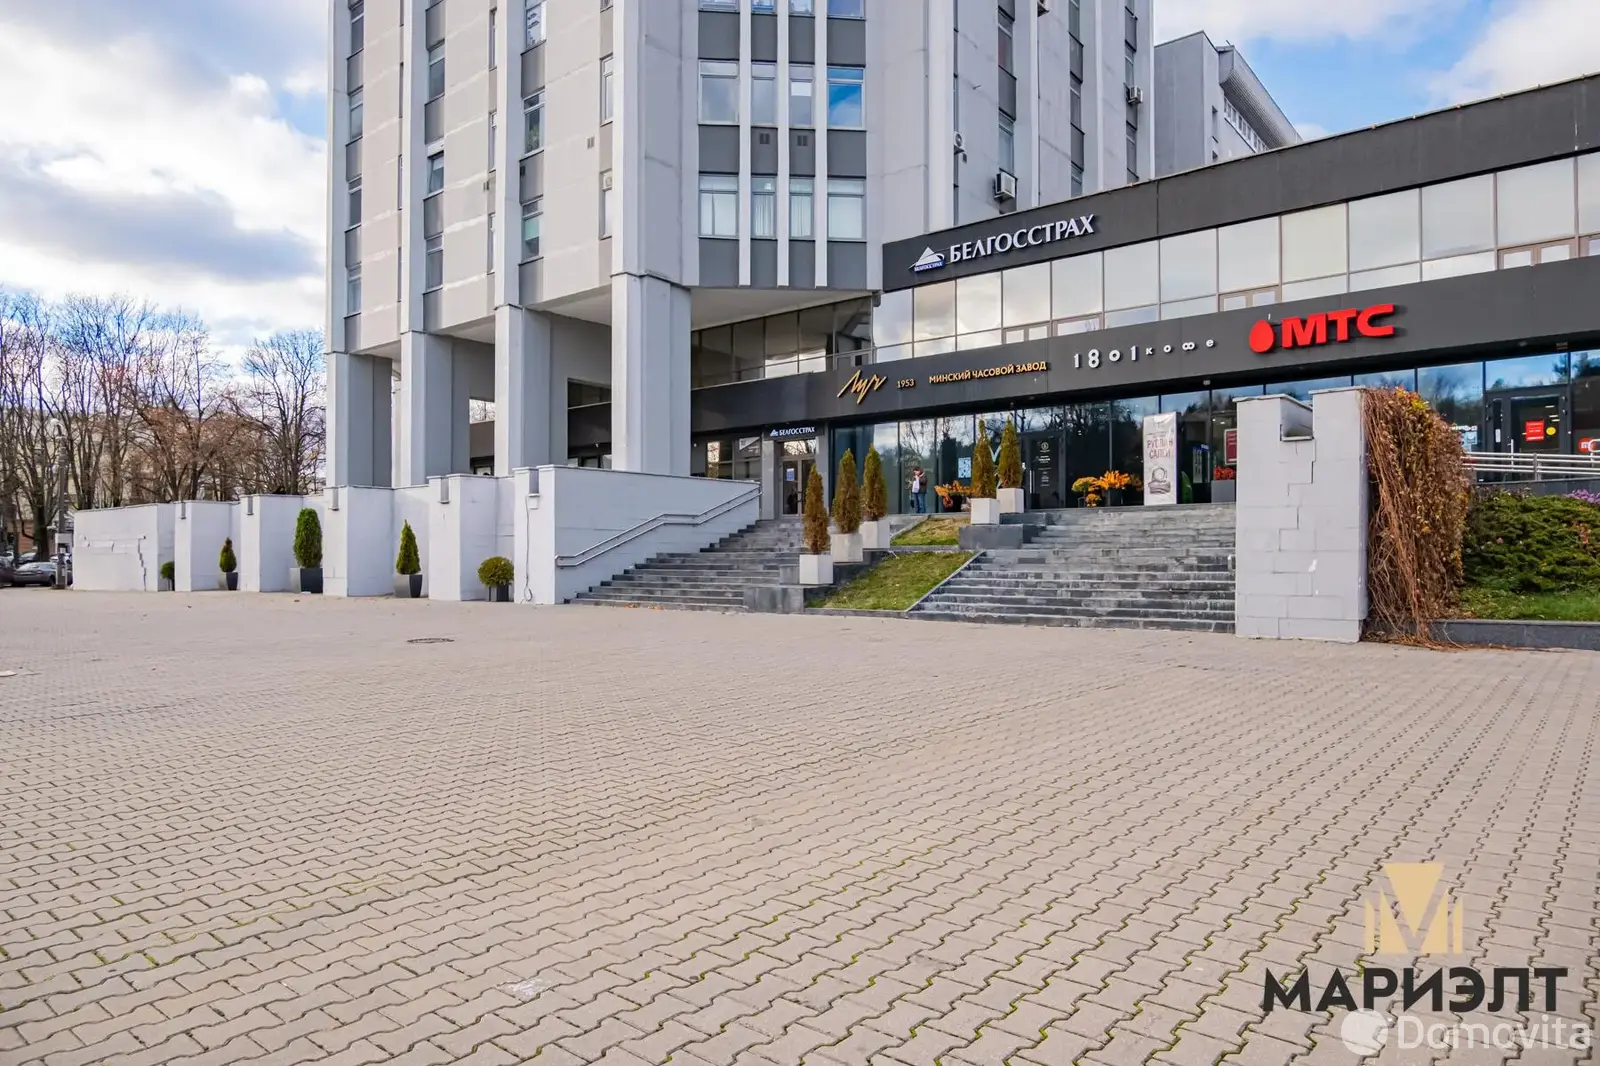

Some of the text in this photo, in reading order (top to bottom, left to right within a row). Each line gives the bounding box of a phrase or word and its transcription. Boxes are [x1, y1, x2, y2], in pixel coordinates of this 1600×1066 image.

[949, 213, 1095, 263] БЕЛГОССТРАХ
[1281, 303, 1395, 349] МТС
[836, 360, 1048, 405] Луч 1953 МИНСКИЙ ЧАСОВОЙ ЗАВОД
[779, 426, 816, 436] БЕЛГОССТРАХ
